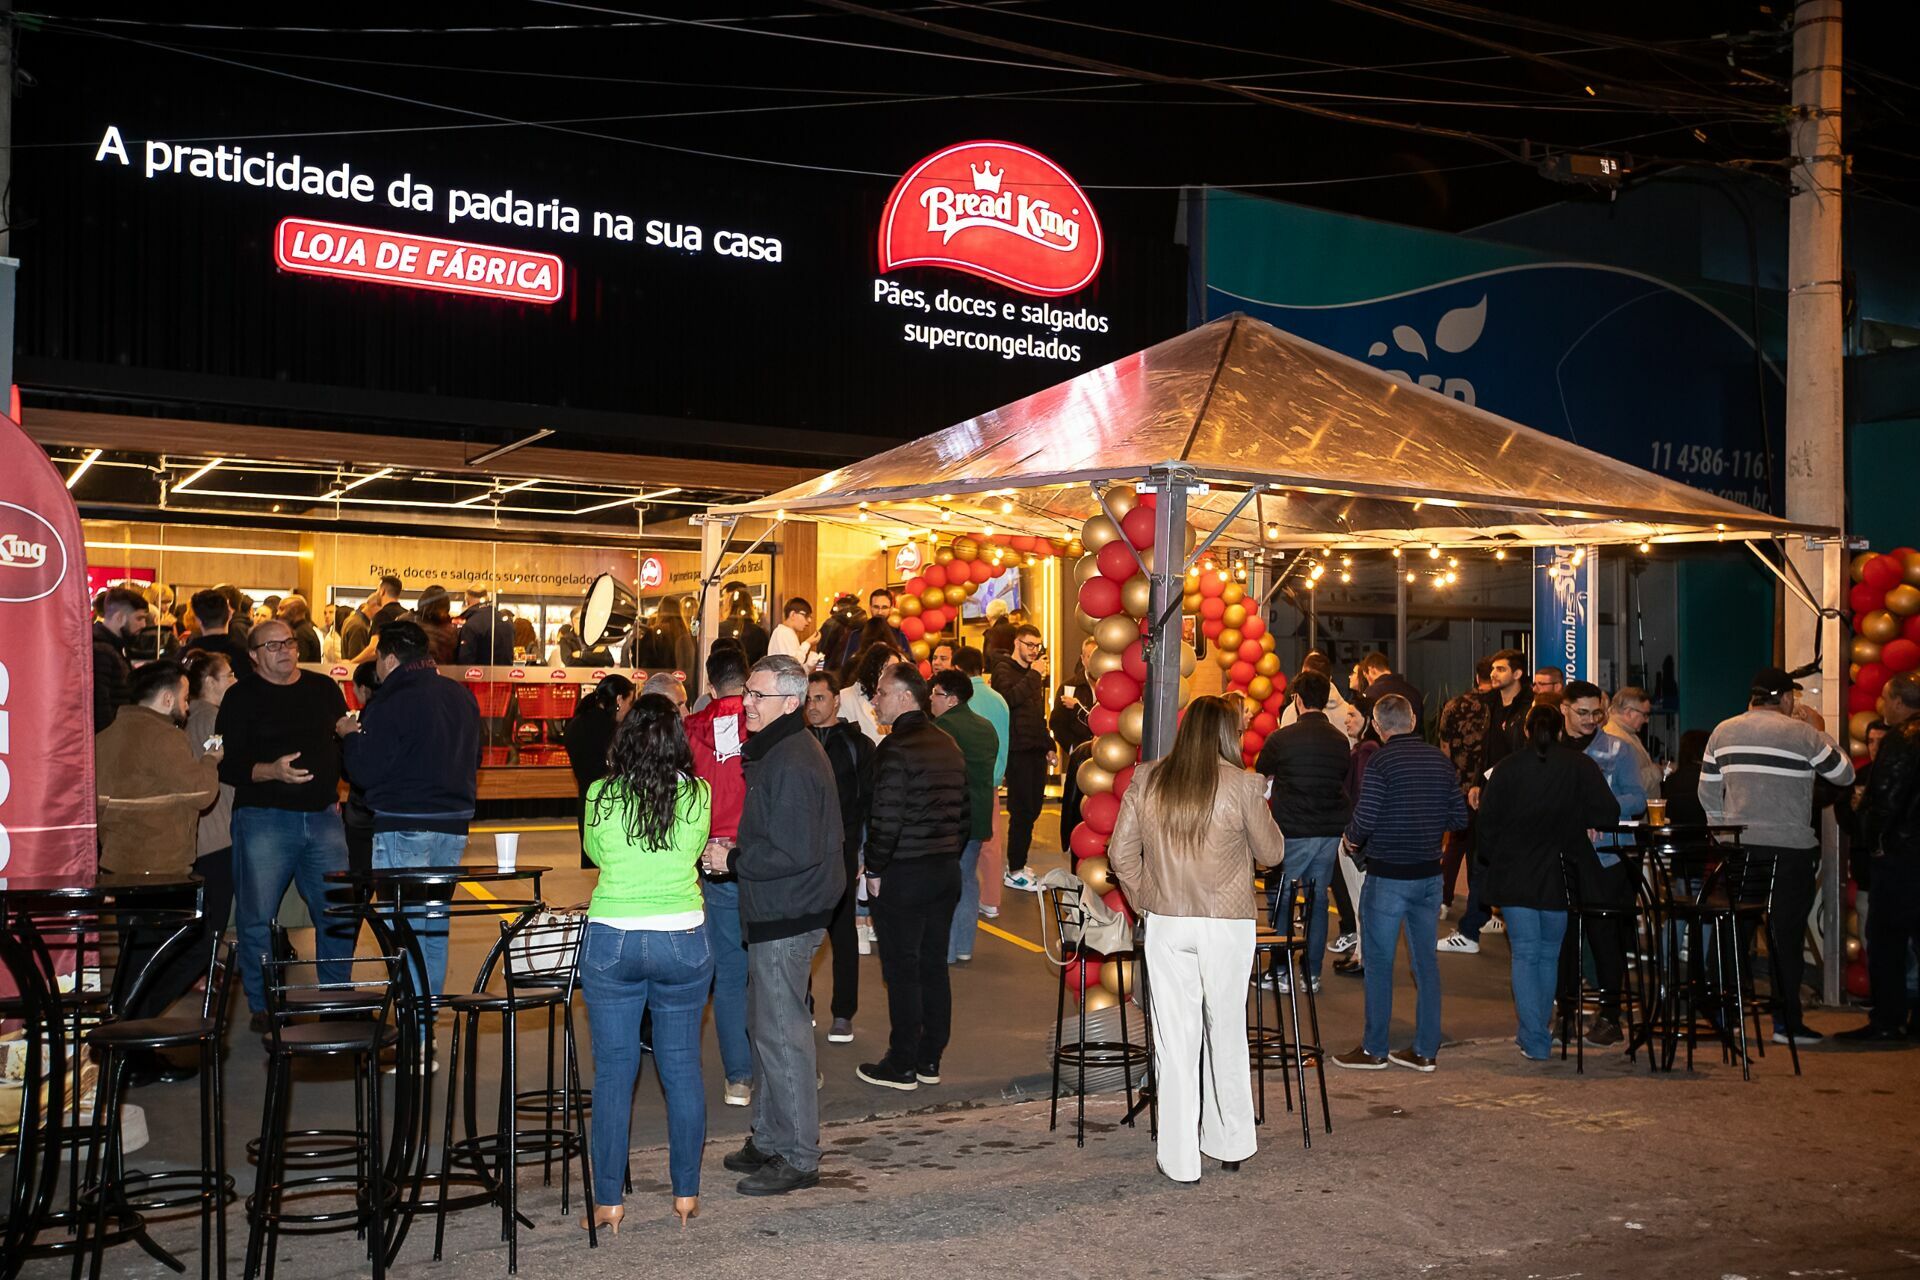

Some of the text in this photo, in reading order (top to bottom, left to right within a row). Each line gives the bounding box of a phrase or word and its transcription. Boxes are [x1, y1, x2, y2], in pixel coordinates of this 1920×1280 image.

[95, 125, 782, 263] A praticidade da padaria na sua casa
[919, 186, 1081, 252] Bread King
[291, 230, 552, 292] LOJA DE FÁBRICA
[874, 278, 1109, 333] Pães, doces e salgados
[903, 322, 1082, 362] supercongelados
[1651, 441, 1672, 470] 11
[370, 564, 600, 586] Pães, doces e salgados supercongelado
